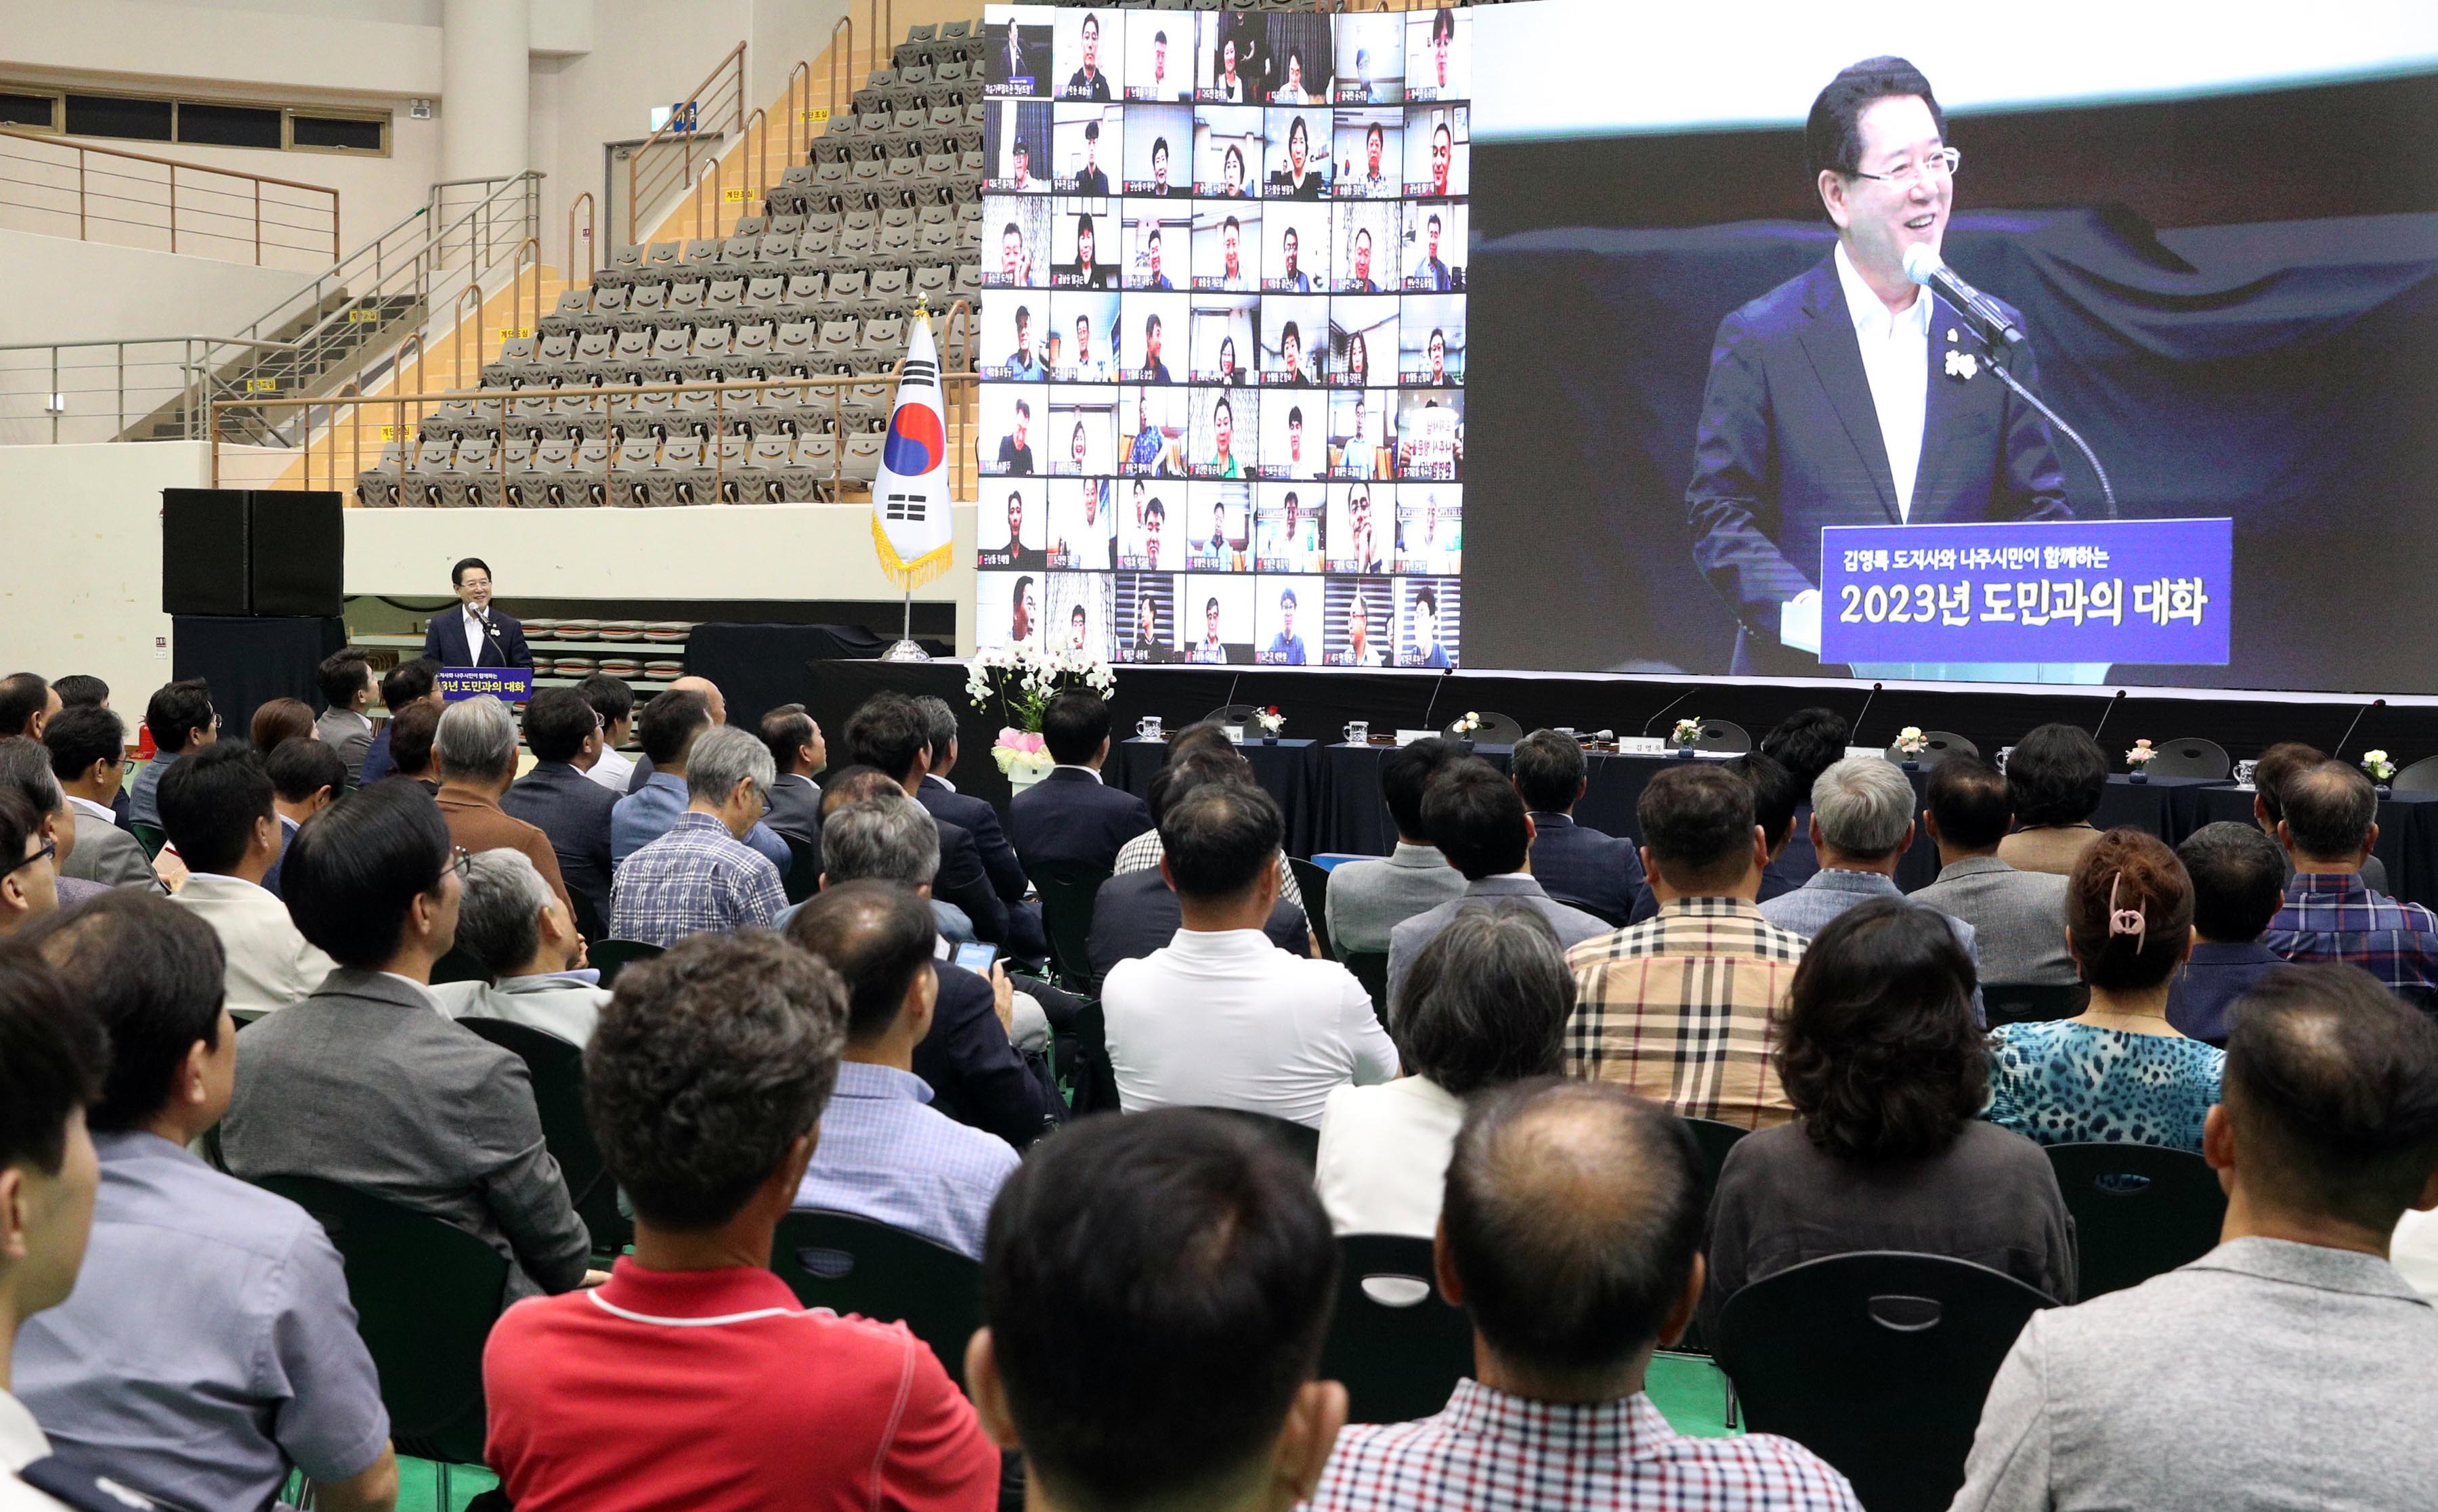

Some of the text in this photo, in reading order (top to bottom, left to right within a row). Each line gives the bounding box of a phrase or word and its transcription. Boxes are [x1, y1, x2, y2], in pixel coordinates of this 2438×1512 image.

[1843, 545, 2110, 573] 김영록 도지사와 나주시민이 함께하는
[1839, 576, 2209, 628] 2023년 도민과의 대화
[461, 681, 502, 693] 도민과의
[504, 681, 526, 693] 대화
